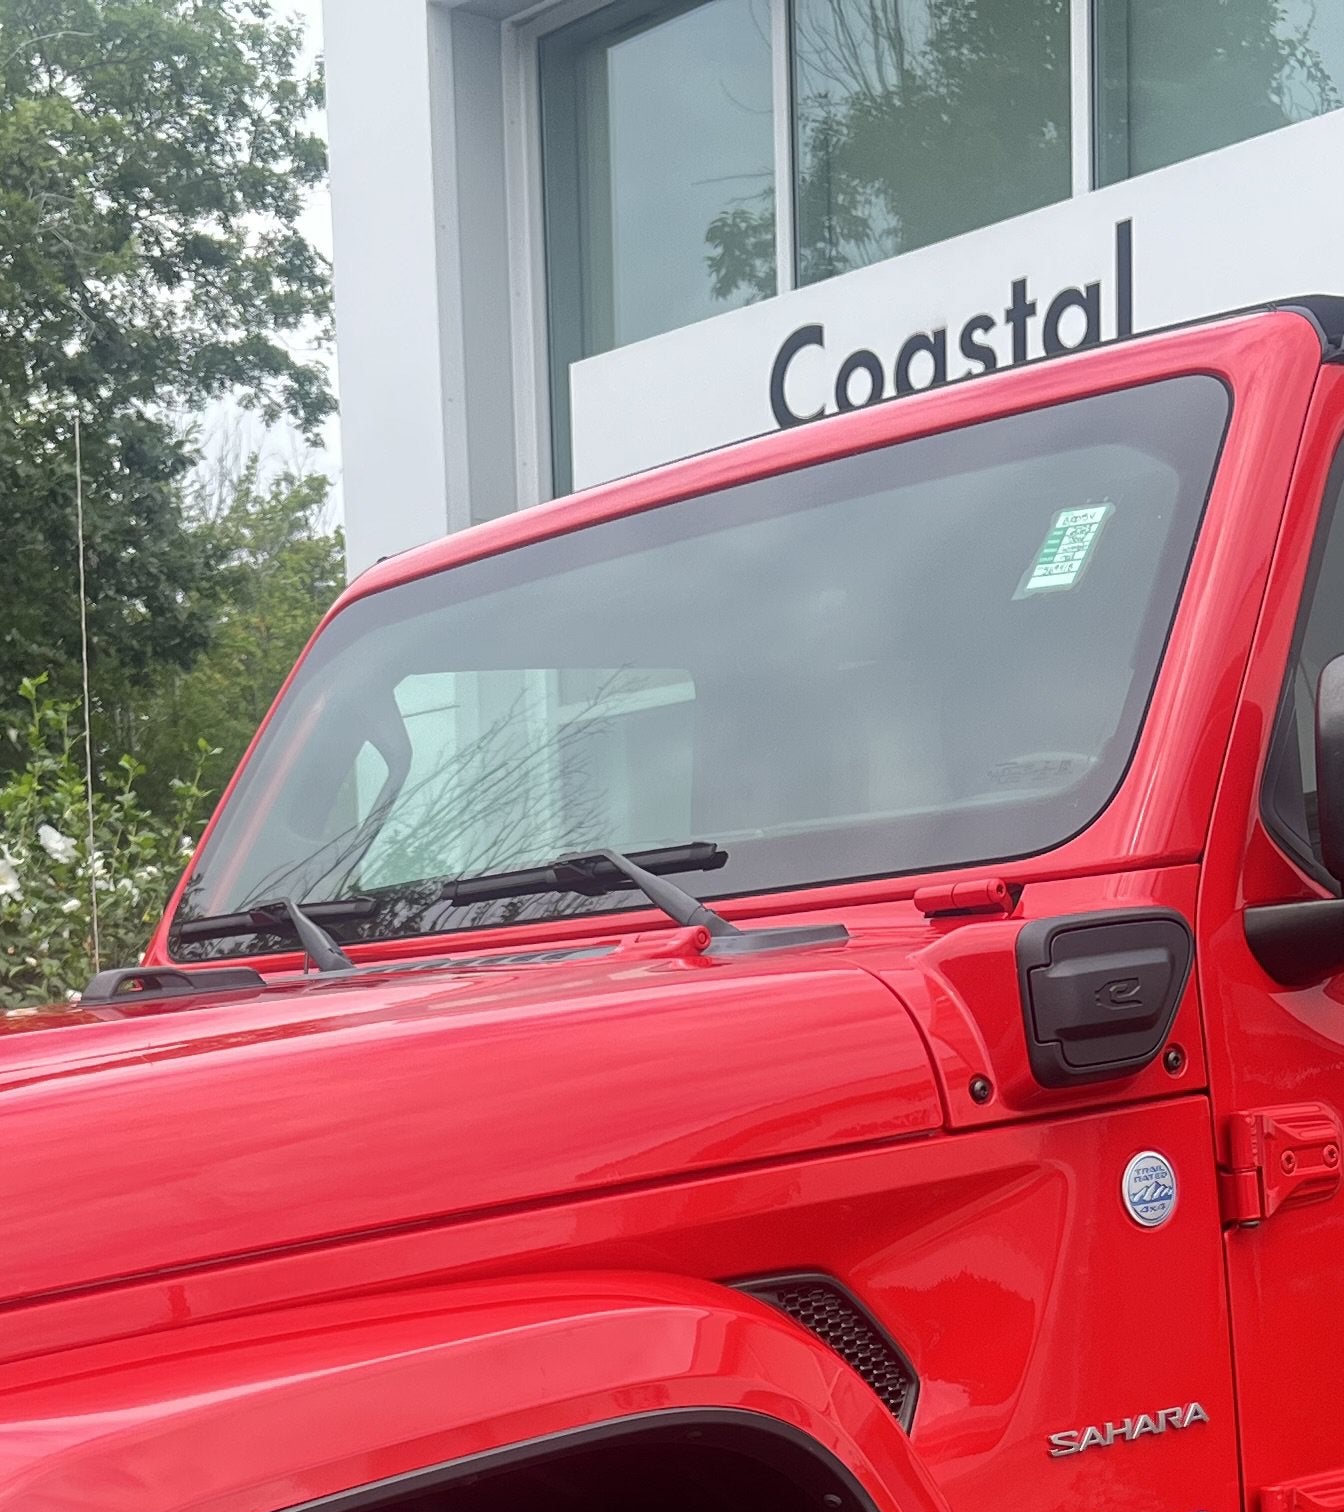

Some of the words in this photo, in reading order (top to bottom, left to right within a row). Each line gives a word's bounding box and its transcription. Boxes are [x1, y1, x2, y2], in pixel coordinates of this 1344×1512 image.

[769, 217, 1132, 428] Coastal
[1134, 1172, 1167, 1182] RATED
[1135, 1165, 1165, 1174] TRAIL
[1047, 1402, 1209, 1458] SAHARA
